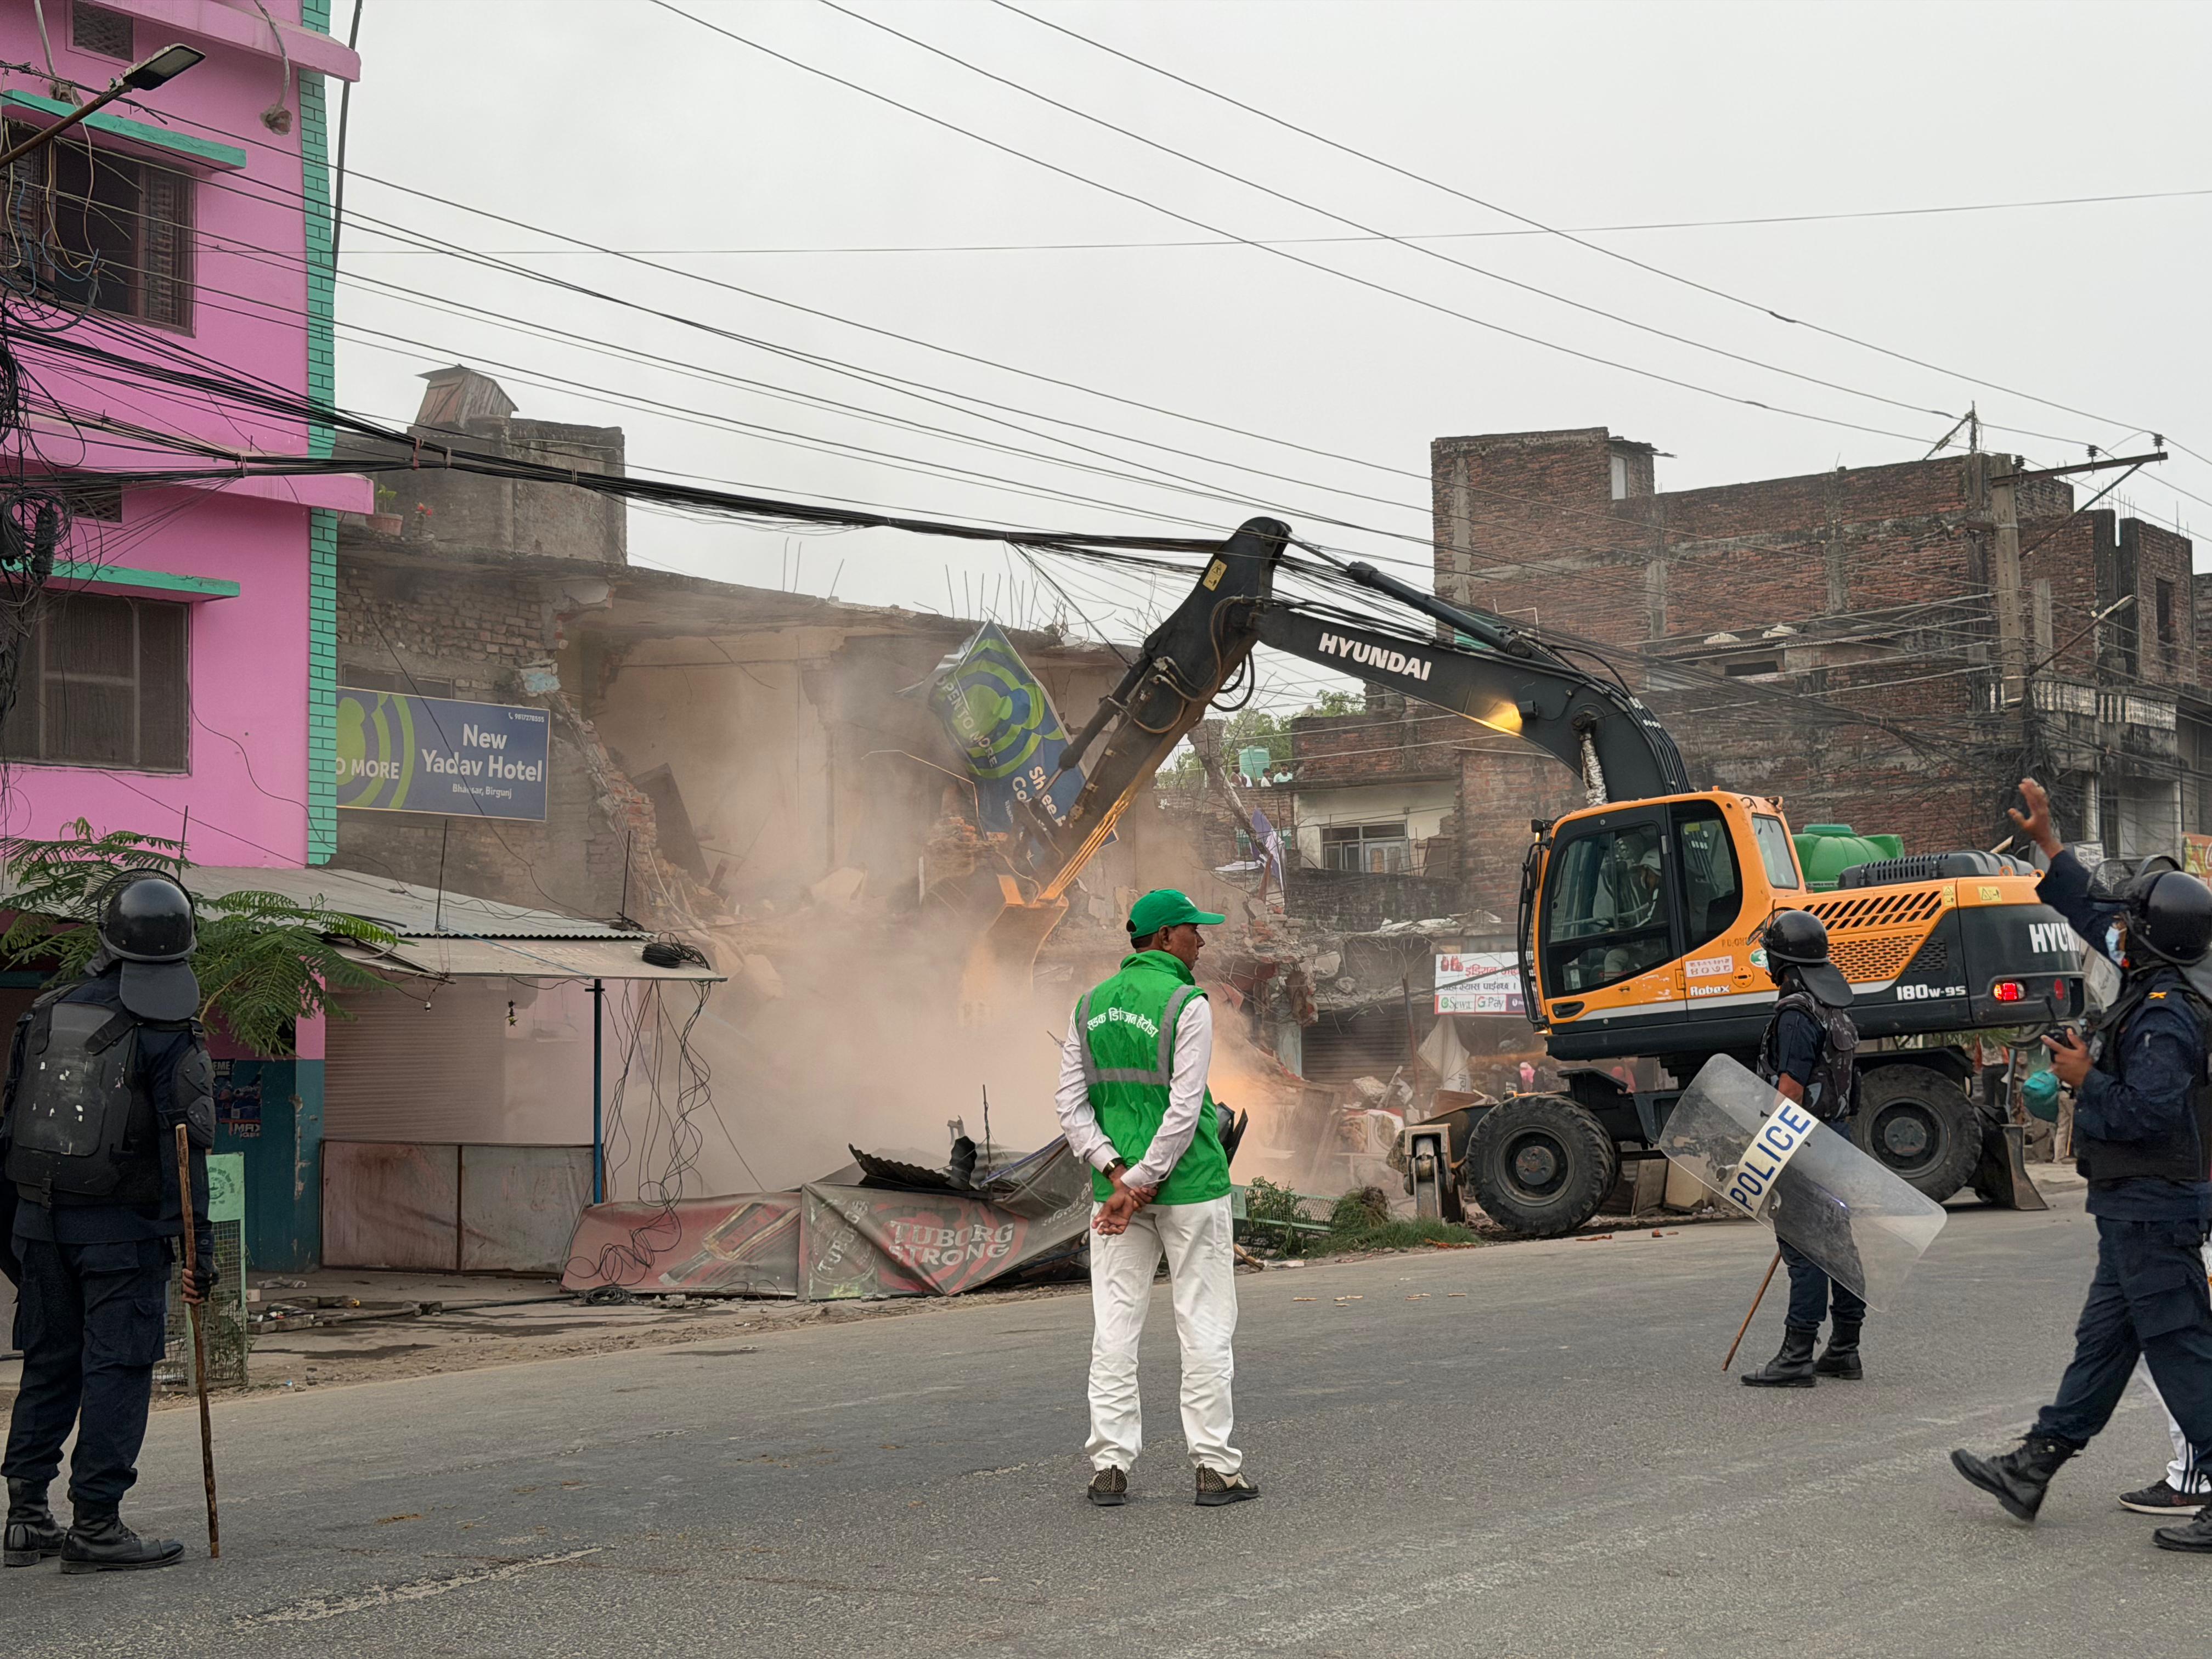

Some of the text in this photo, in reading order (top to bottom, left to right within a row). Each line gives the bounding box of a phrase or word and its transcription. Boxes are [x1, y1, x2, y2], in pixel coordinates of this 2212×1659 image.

[1318, 633, 1432, 681] HYUNDAI
[462, 724, 507, 750] New
[969, 730, 997, 768] MORE
[351, 759, 400, 780] MORE
[421, 749, 542, 782] Yadav Hotel
[486, 786, 512, 799] Birgunj
[1029, 766, 1057, 815] Shee
[1690, 985, 1730, 996] Robex
[1729, 1105, 1811, 1212] POLICE
[889, 1220, 1014, 1248] TUBORG
[889, 1243, 1011, 1266] STRONG
